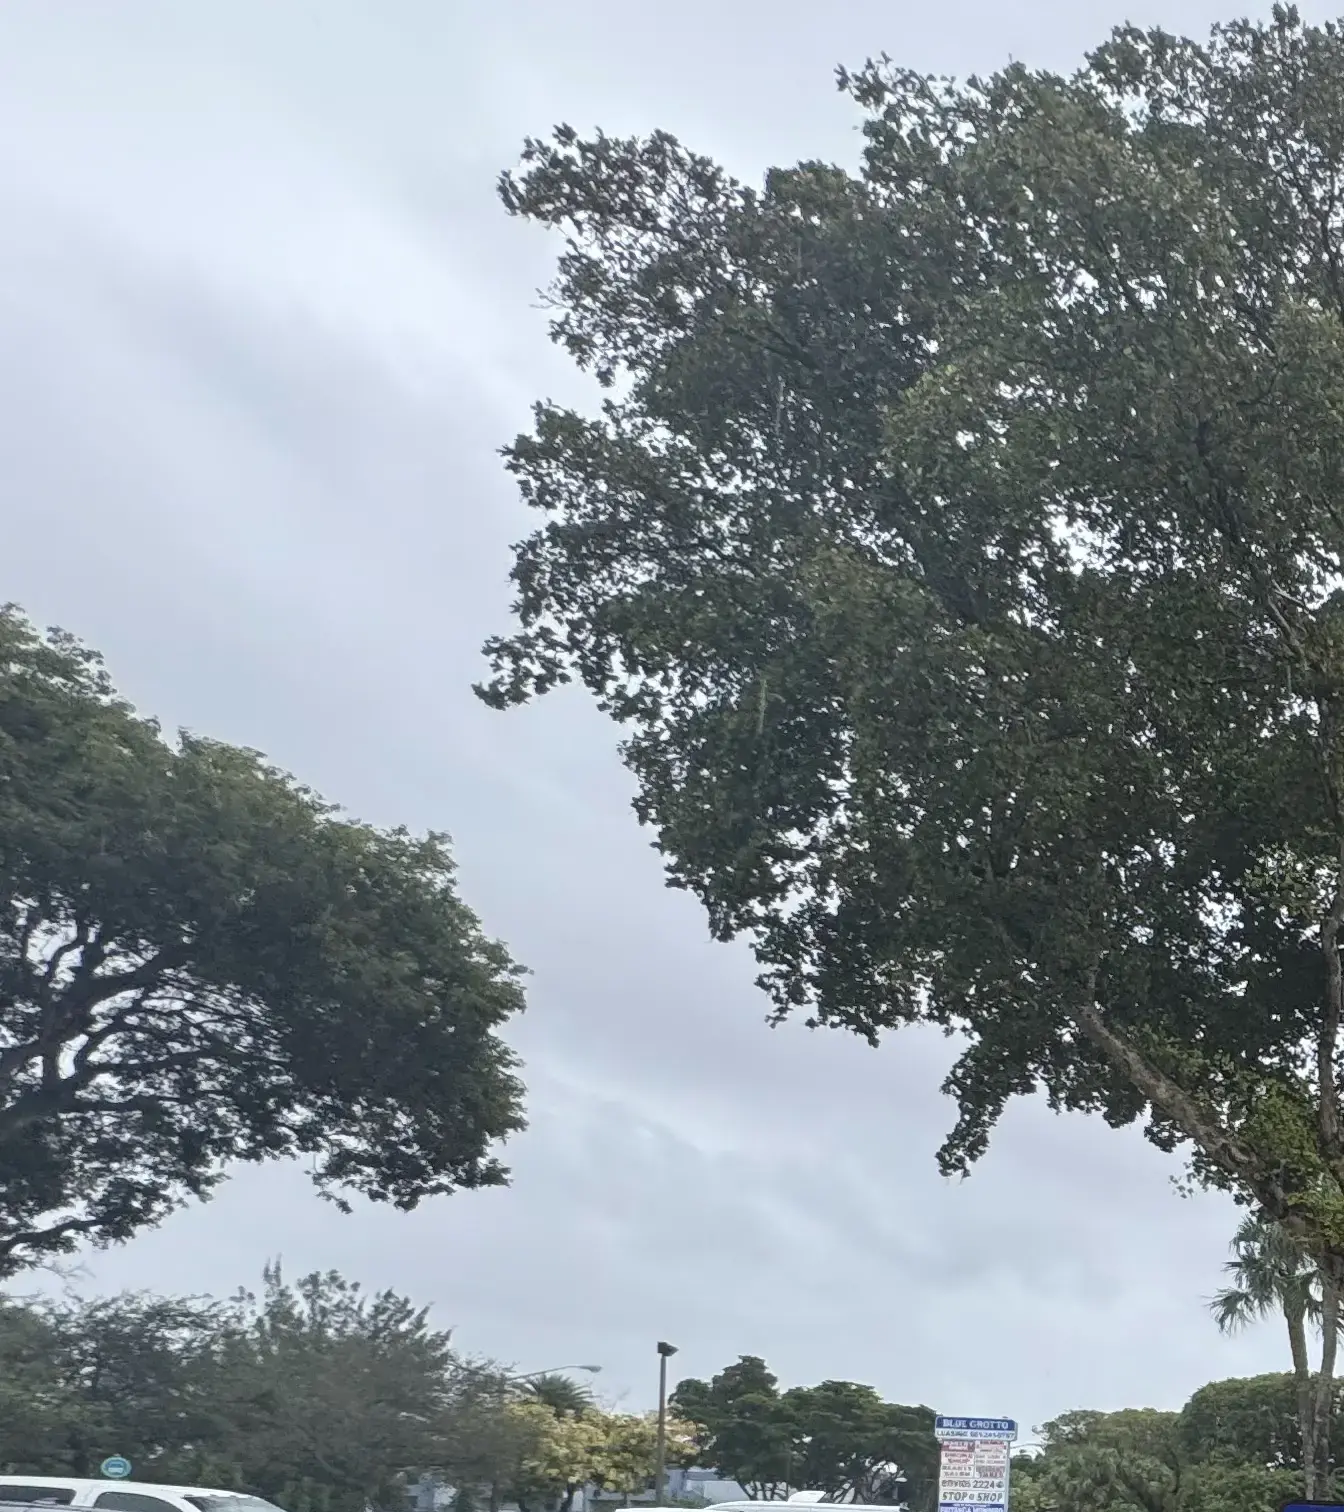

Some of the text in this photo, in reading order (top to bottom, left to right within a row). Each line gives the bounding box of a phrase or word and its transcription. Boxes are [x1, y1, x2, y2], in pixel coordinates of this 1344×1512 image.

[942, 1419, 1009, 1429] BLUE GROTTO
[942, 1491, 968, 1501] STOP
[977, 1492, 1003, 1502] SHOP
